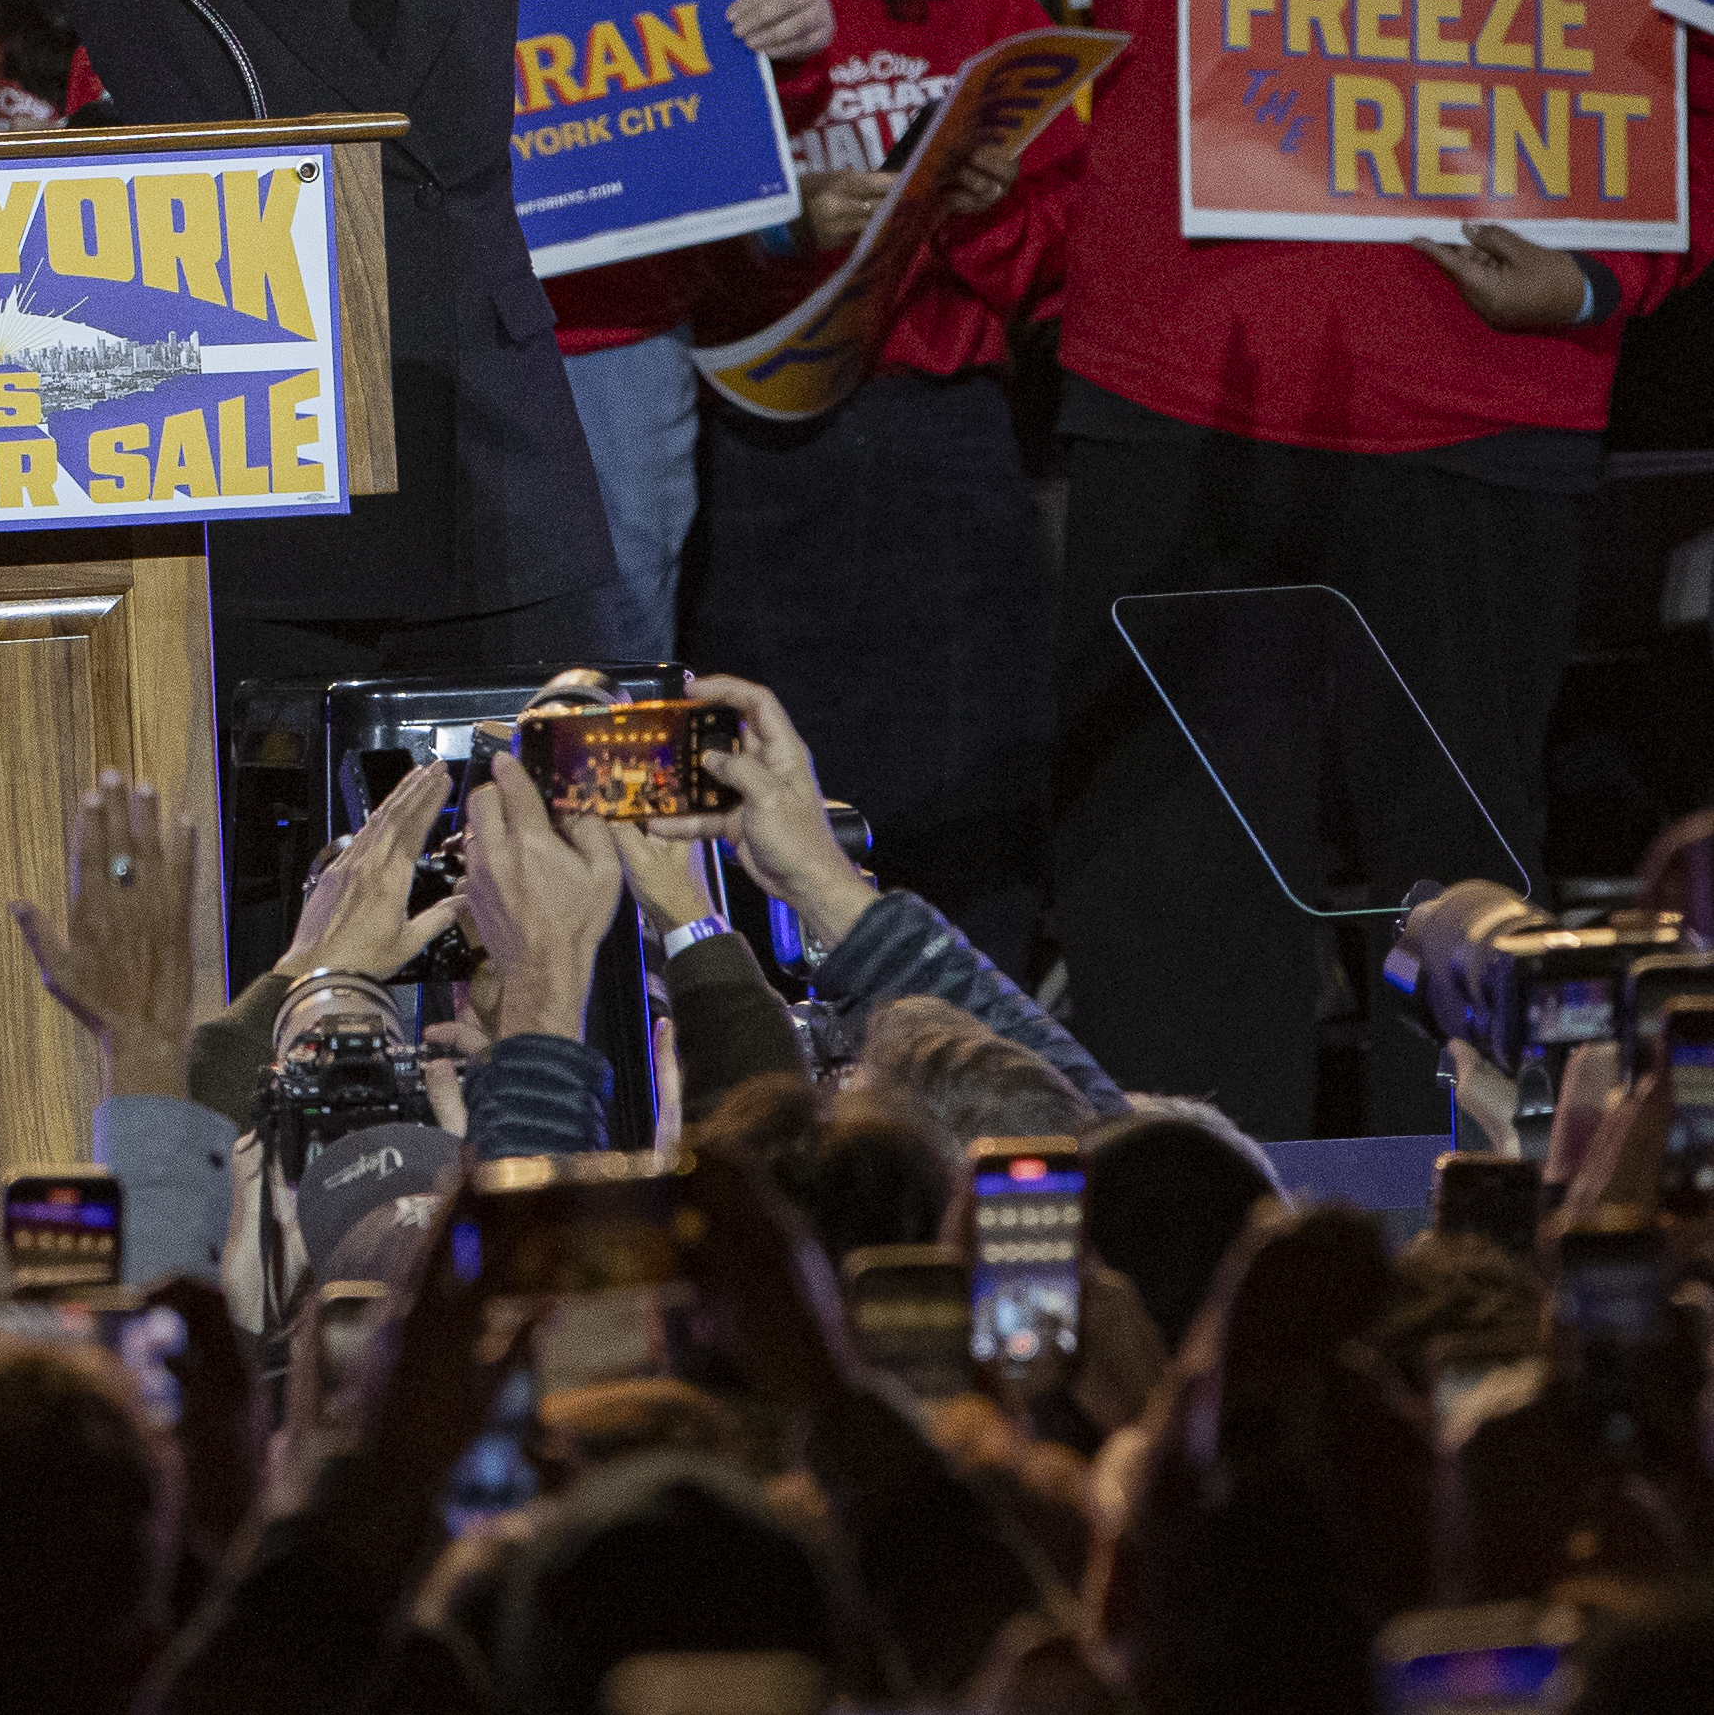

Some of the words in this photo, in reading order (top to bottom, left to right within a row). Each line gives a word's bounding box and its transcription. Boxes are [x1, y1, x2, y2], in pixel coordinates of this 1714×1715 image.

[510, 114, 613, 161] YORK
[617, 94, 702, 137] CITY
[1242, 68, 1314, 153] THE
[1328, 73, 1651, 203] RENT
[87, 367, 326, 504] SALE
